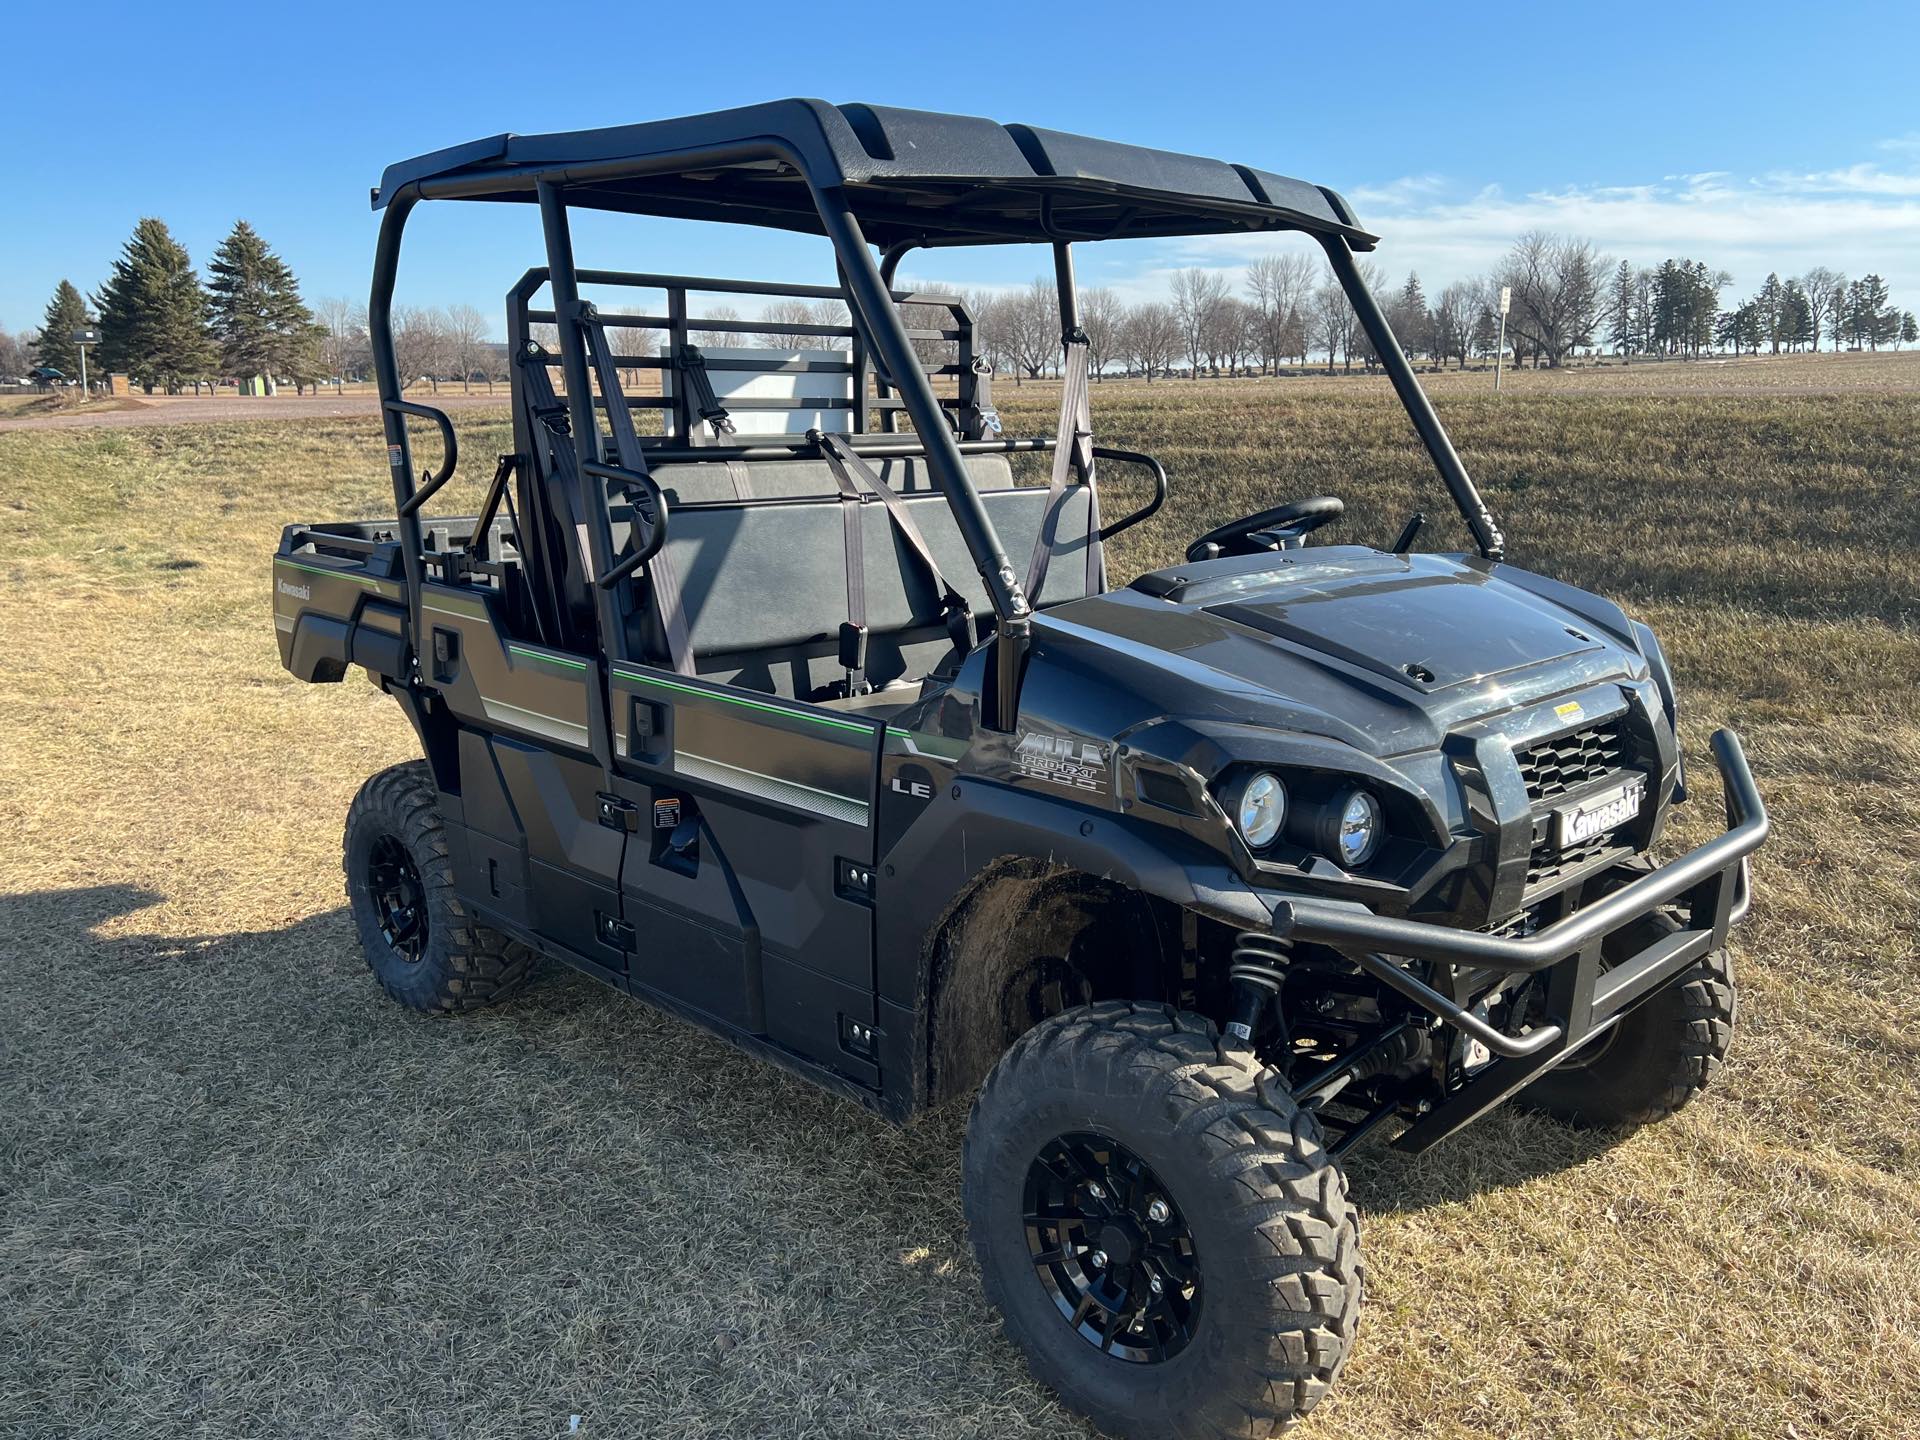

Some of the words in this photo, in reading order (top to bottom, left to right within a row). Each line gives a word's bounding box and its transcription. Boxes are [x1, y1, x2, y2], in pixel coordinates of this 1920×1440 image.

[277, 577, 310, 601] Kawasaki
[1014, 732, 1107, 772] MULE
[1021, 754, 1097, 779] PRO-FXT
[892, 778, 930, 799] LE
[1560, 785, 1640, 847] Kawasaki
